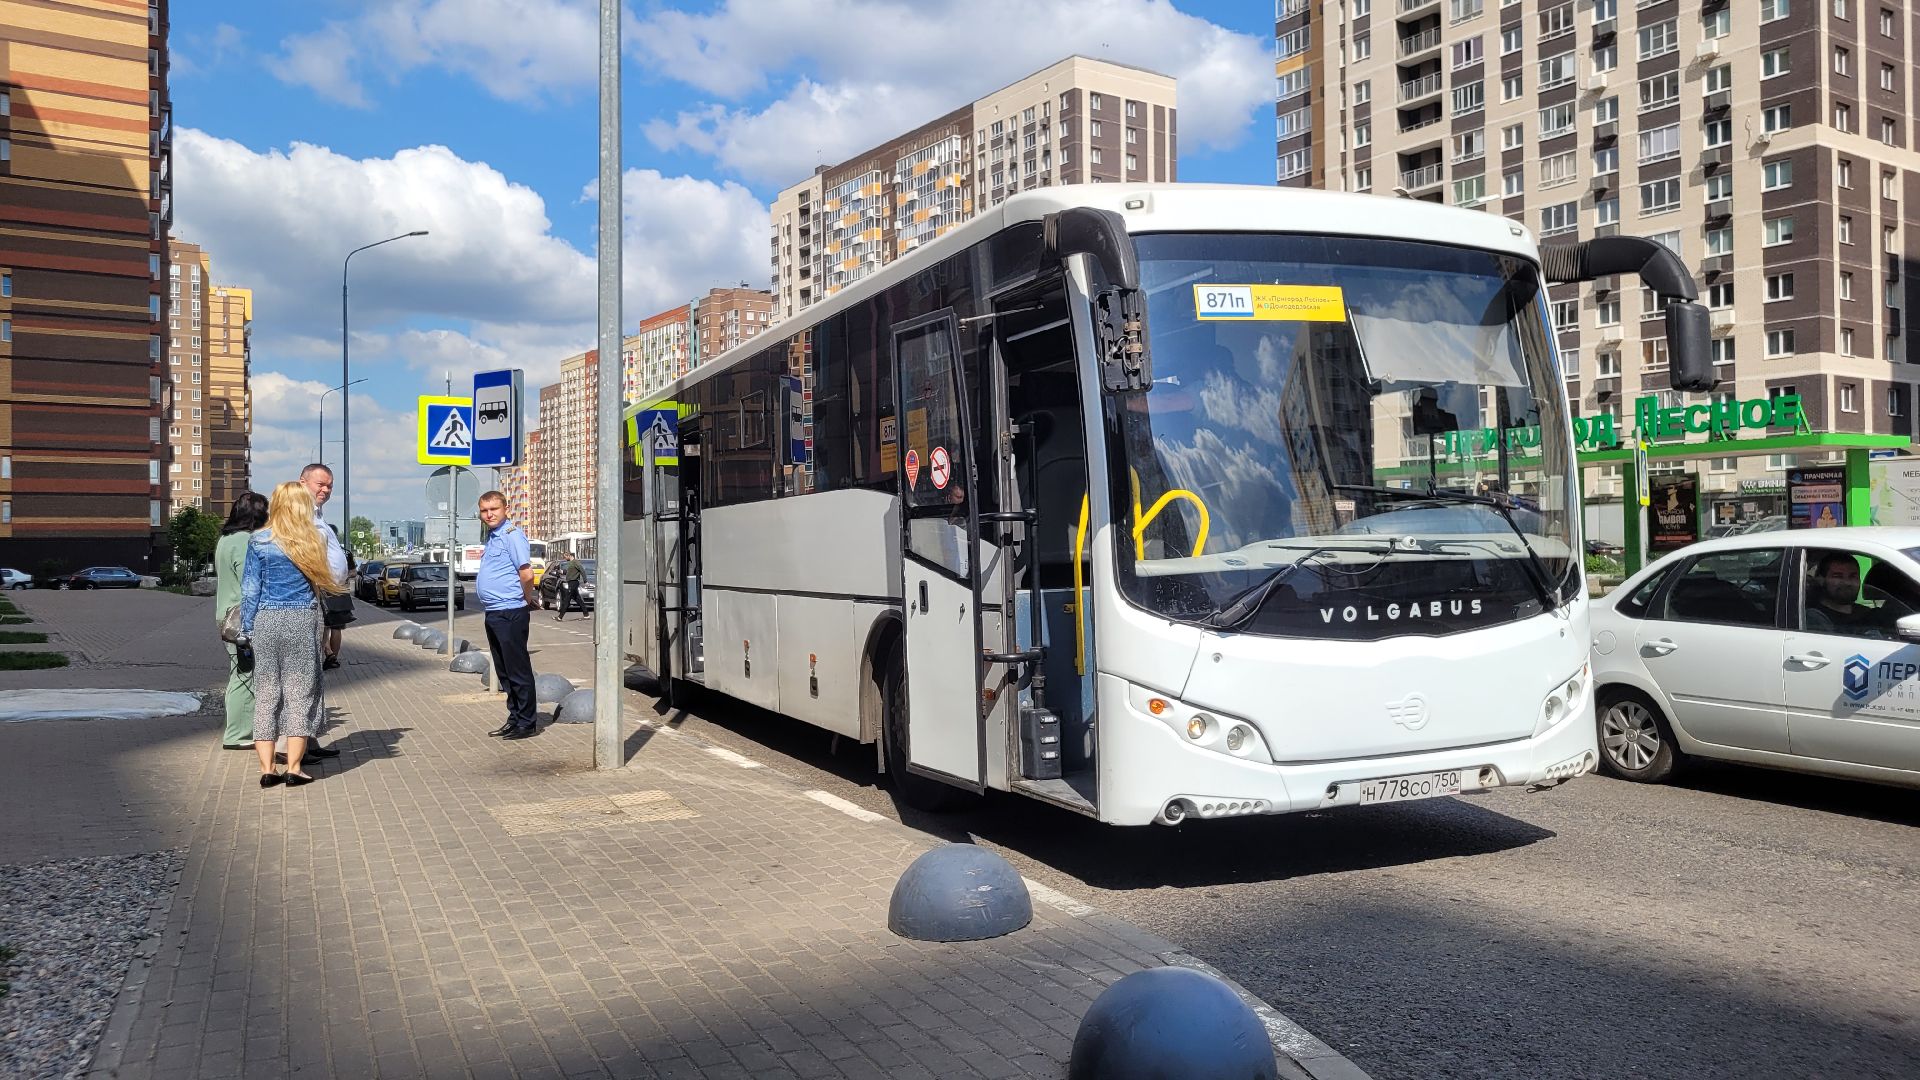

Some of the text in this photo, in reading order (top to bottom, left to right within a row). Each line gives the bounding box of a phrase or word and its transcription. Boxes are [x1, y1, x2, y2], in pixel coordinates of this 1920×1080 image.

[1206, 292, 1245, 308] 871п
[1633, 394, 1802, 438] ЛЕСНОЕ
[1804, 471, 1843, 480] ПРАЧЕЧНАЯ
[1320, 599, 1482, 623] VOLGABUS
[1434, 772, 1457, 789] 750
